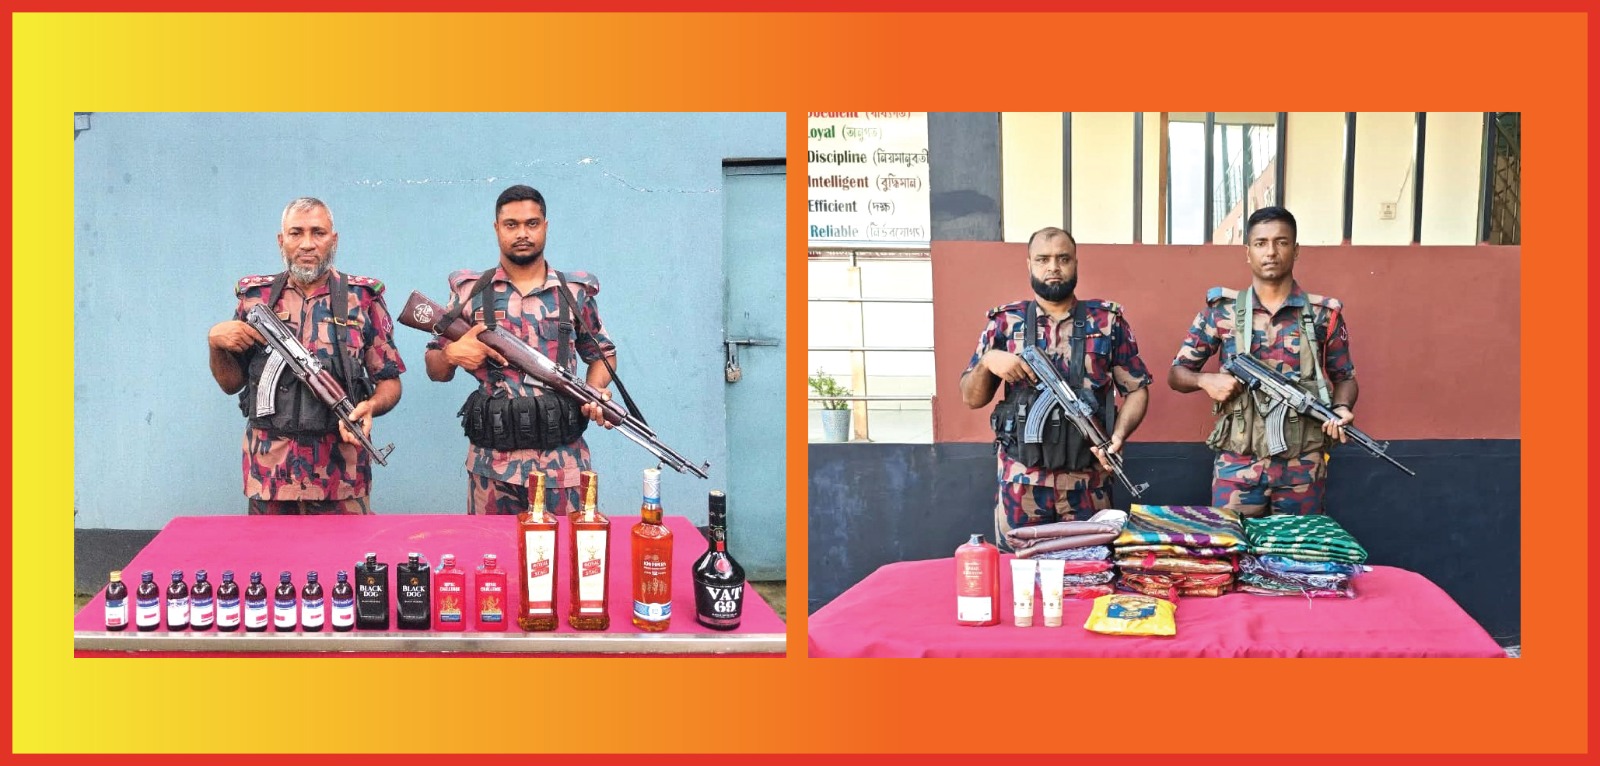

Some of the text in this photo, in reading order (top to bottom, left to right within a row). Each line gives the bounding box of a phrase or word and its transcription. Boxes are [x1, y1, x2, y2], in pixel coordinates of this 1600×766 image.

[808, 125, 836, 141] oyal
[808, 150, 868, 166] Discipline
[808, 175, 869, 190] Intelligent
[808, 199, 896, 215] Efficient (দক্ষ)
[810, 224, 859, 237] Reliable
[359, 584, 382, 592] BLACK
[705, 586, 742, 601] VAT
[713, 600, 737, 613] 69
